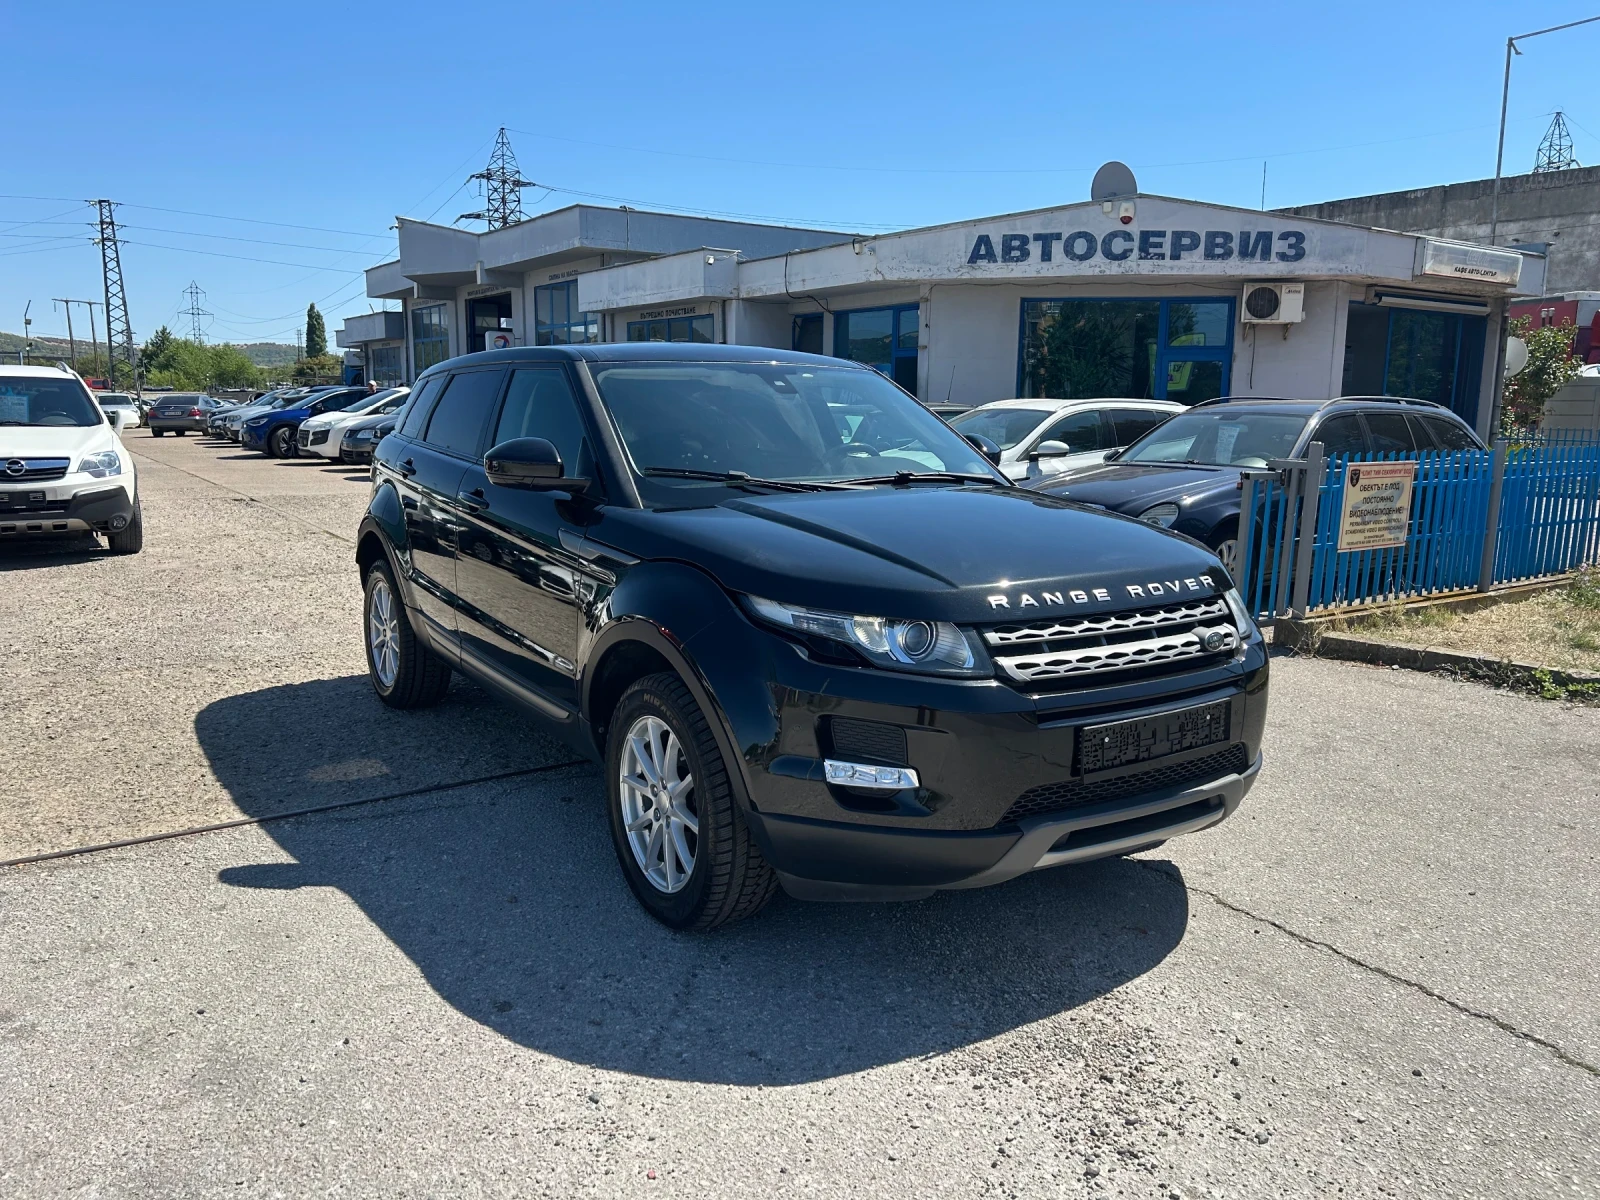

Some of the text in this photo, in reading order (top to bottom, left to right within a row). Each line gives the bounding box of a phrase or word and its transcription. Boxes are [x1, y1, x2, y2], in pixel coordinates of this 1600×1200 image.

[967, 230, 1306, 264] АВТОСЕРВИЗ
[1360, 483, 1384, 492] ОБЕКТЪТ
[1389, 482, 1400, 491] ПОД
[1362, 495, 1394, 504] ПОСТОЯННО
[987, 575, 1215, 609] RANGE ROVER
